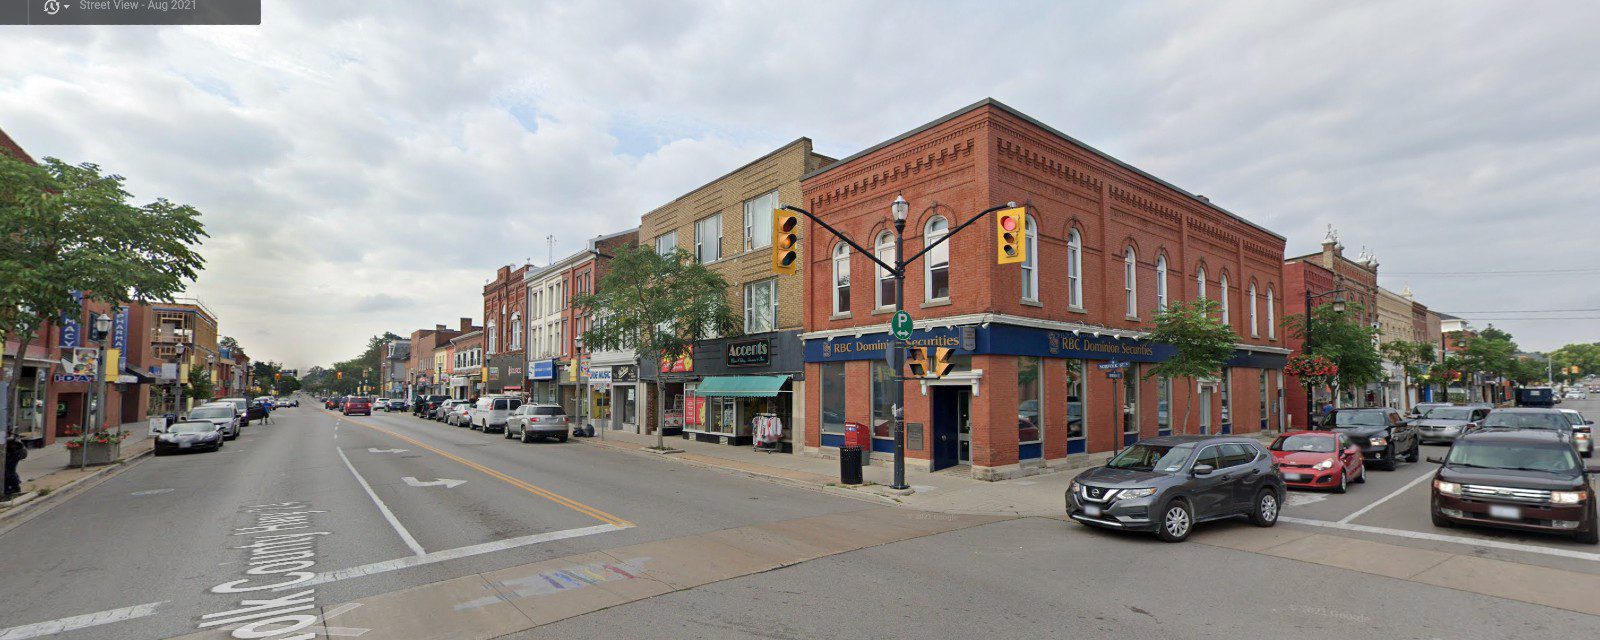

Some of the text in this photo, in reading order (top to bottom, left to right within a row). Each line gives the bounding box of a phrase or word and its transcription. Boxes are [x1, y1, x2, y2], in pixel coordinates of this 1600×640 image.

[898, 313, 908, 328] P
[728, 341, 768, 358] Accents
[834, 342, 853, 354] RBC
[856, 338, 889, 352] Domini
[905, 334, 960, 348] Securities
[1061, 337, 1153, 356] RBC Dominion Securities
